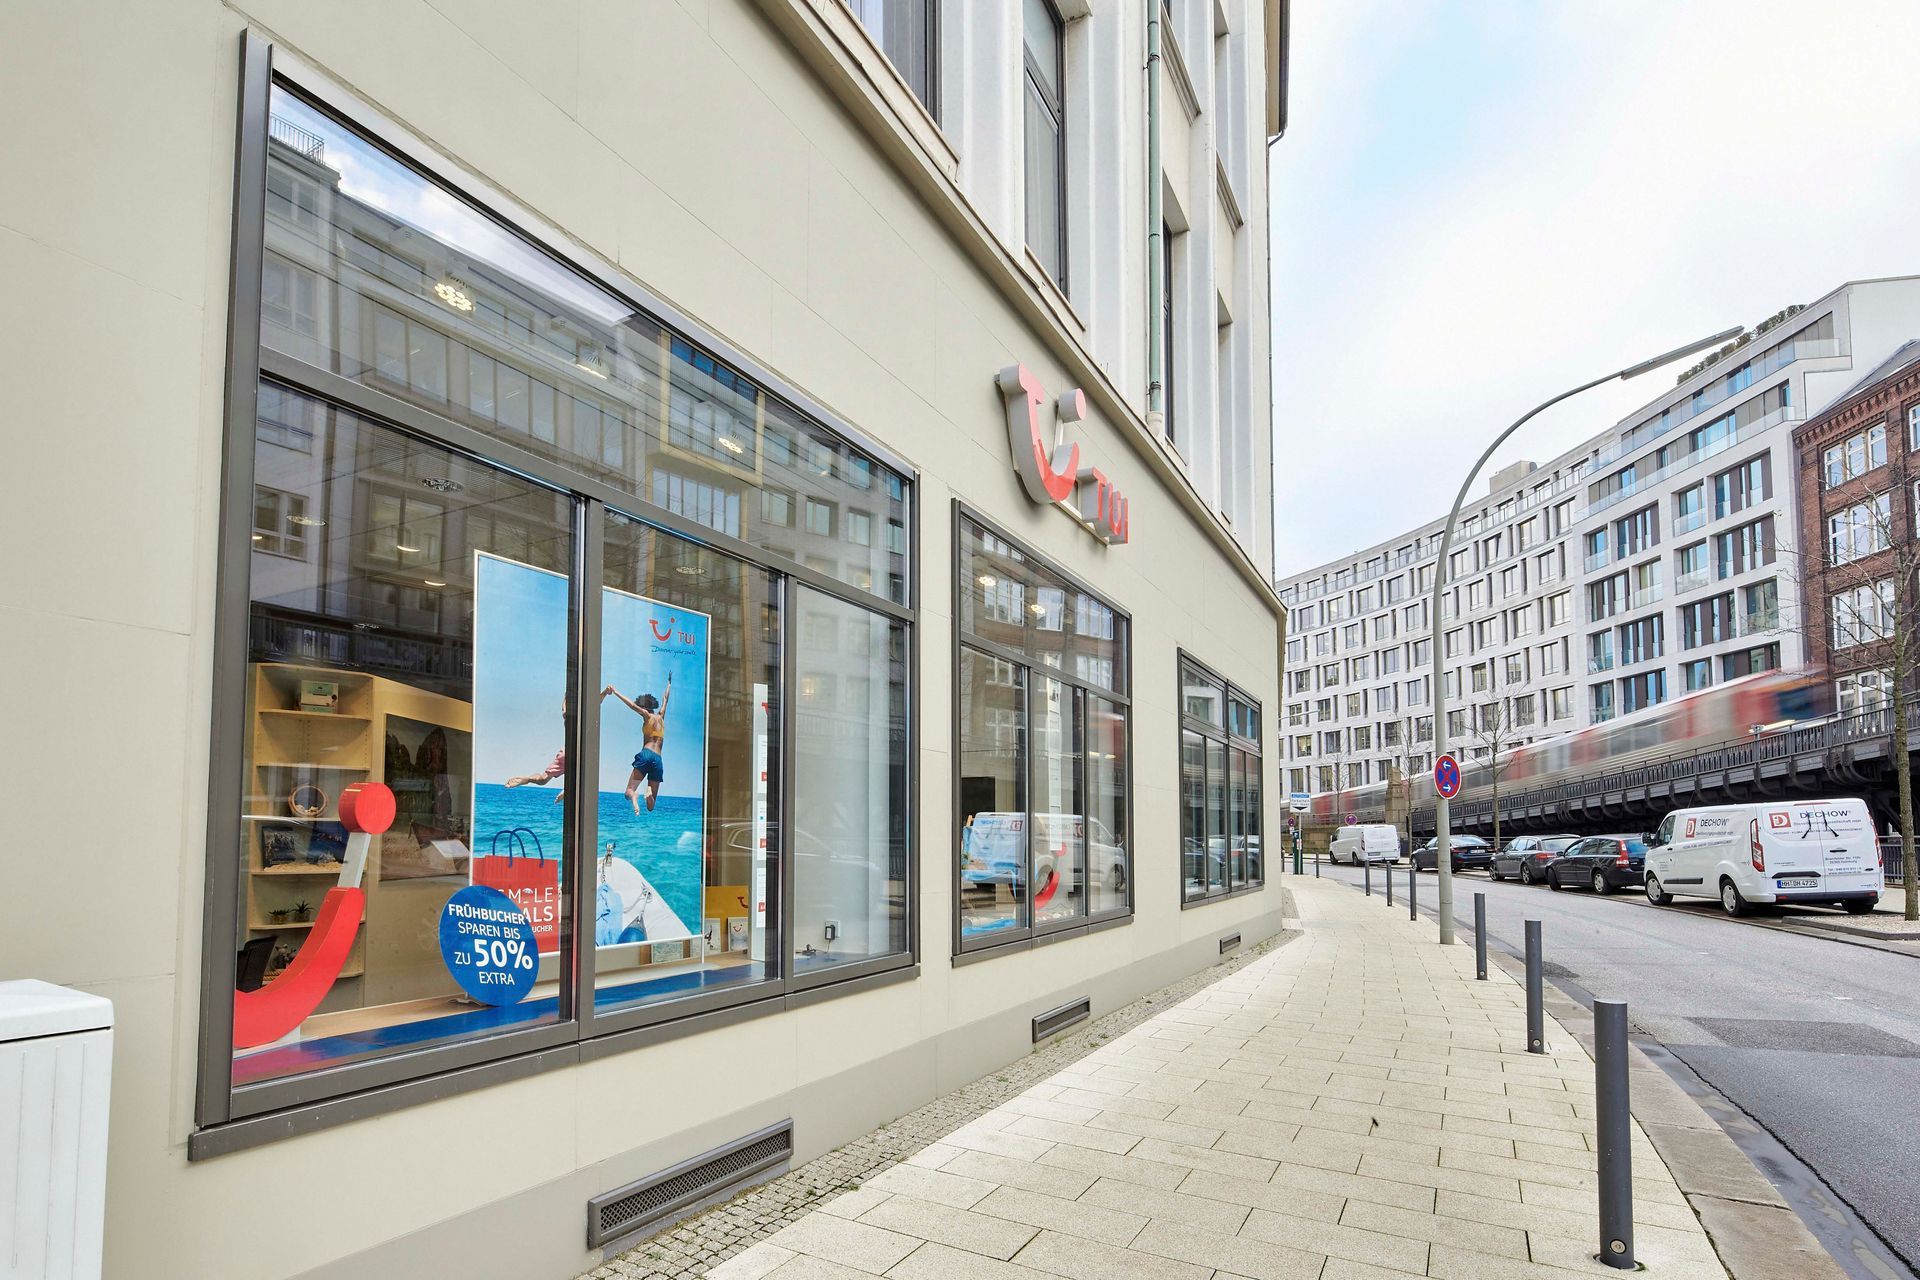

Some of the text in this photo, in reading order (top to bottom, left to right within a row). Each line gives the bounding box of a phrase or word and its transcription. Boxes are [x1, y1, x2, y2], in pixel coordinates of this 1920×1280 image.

[1078, 466, 1128, 544] TUI
[677, 631, 695, 645] TUI
[1700, 818, 1728, 827] DECHOW
[1800, 810, 1849, 819] DECHOW
[448, 903, 525, 925] FRÜHBUCHER
[522, 906, 553, 923] ALS
[458, 922, 520, 940] SPAREN BIS
[532, 925, 552, 933] UCHER
[454, 938, 533, 970] ZU 50%
[479, 971, 515, 986] EXTRA
